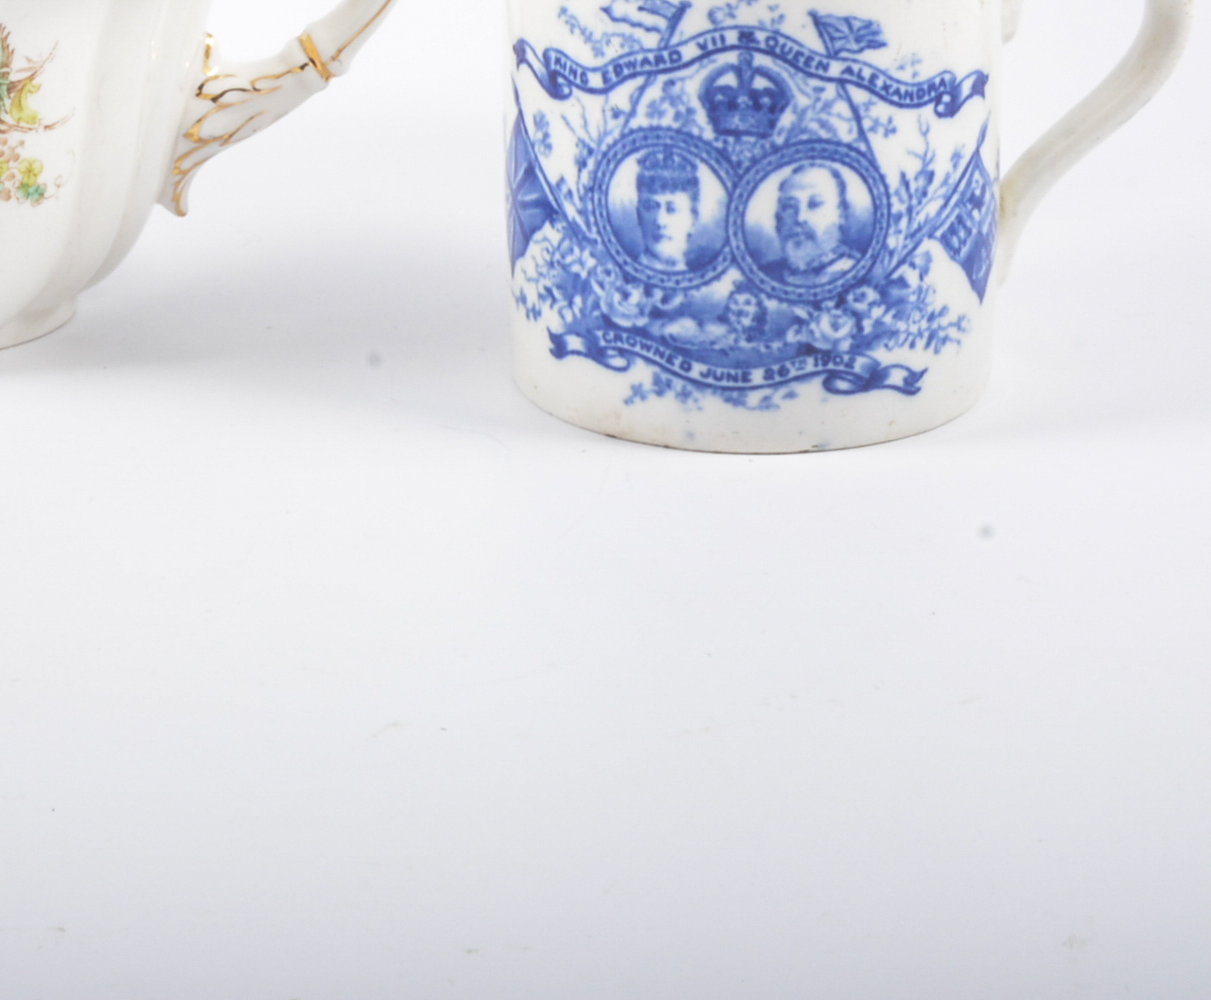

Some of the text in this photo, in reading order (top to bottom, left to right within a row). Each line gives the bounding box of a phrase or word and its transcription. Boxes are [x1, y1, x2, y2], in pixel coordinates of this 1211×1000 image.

[553, 54, 590, 86] KING
[601, 49, 682, 86] EDWARD
[696, 33, 726, 51] VII
[764, 35, 831, 74] QUEEN
[840, 64, 948, 102] ALEXANDRA
[602, 329, 693, 373] CROWNED
[699, 367, 752, 384] JUNE
[813, 351, 857, 370] 1902
